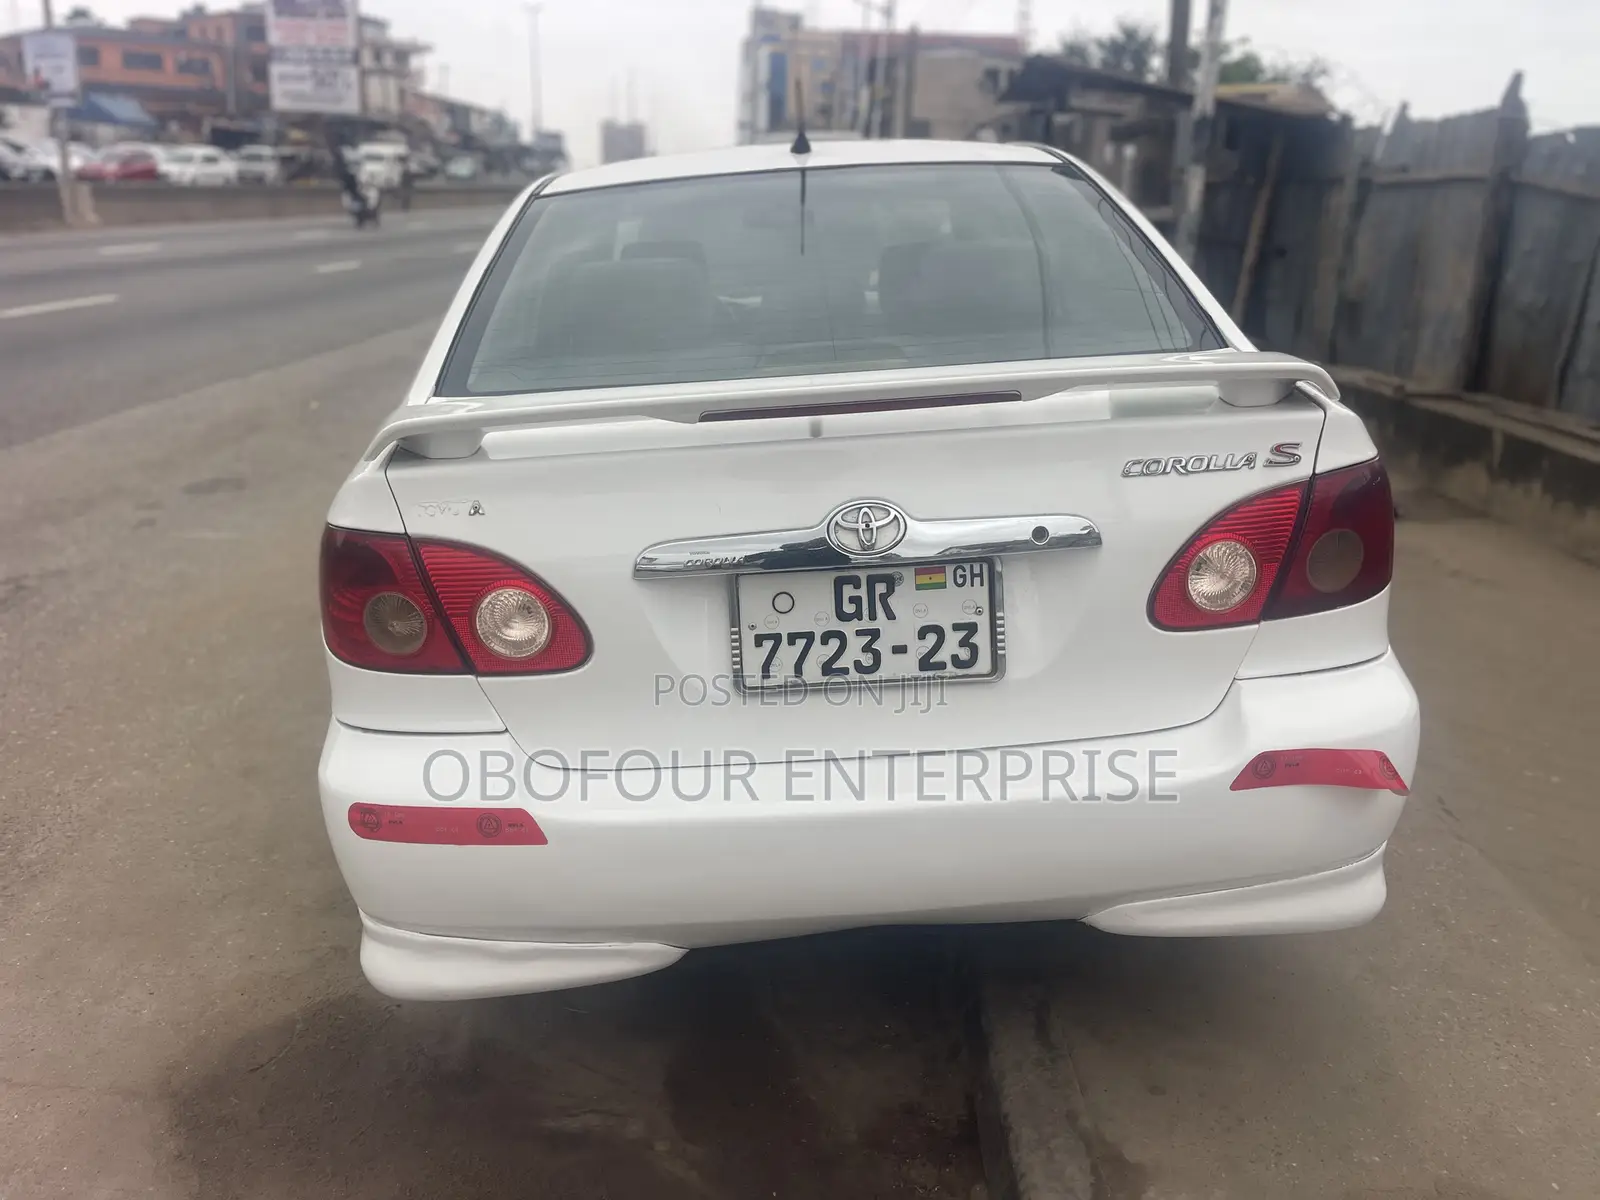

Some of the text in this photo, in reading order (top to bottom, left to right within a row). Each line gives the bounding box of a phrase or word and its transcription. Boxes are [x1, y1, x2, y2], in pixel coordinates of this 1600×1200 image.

[1121, 442, 1302, 477] COROLLA S
[834, 563, 984, 622] GR GH
[754, 621, 979, 679] 7723-23
